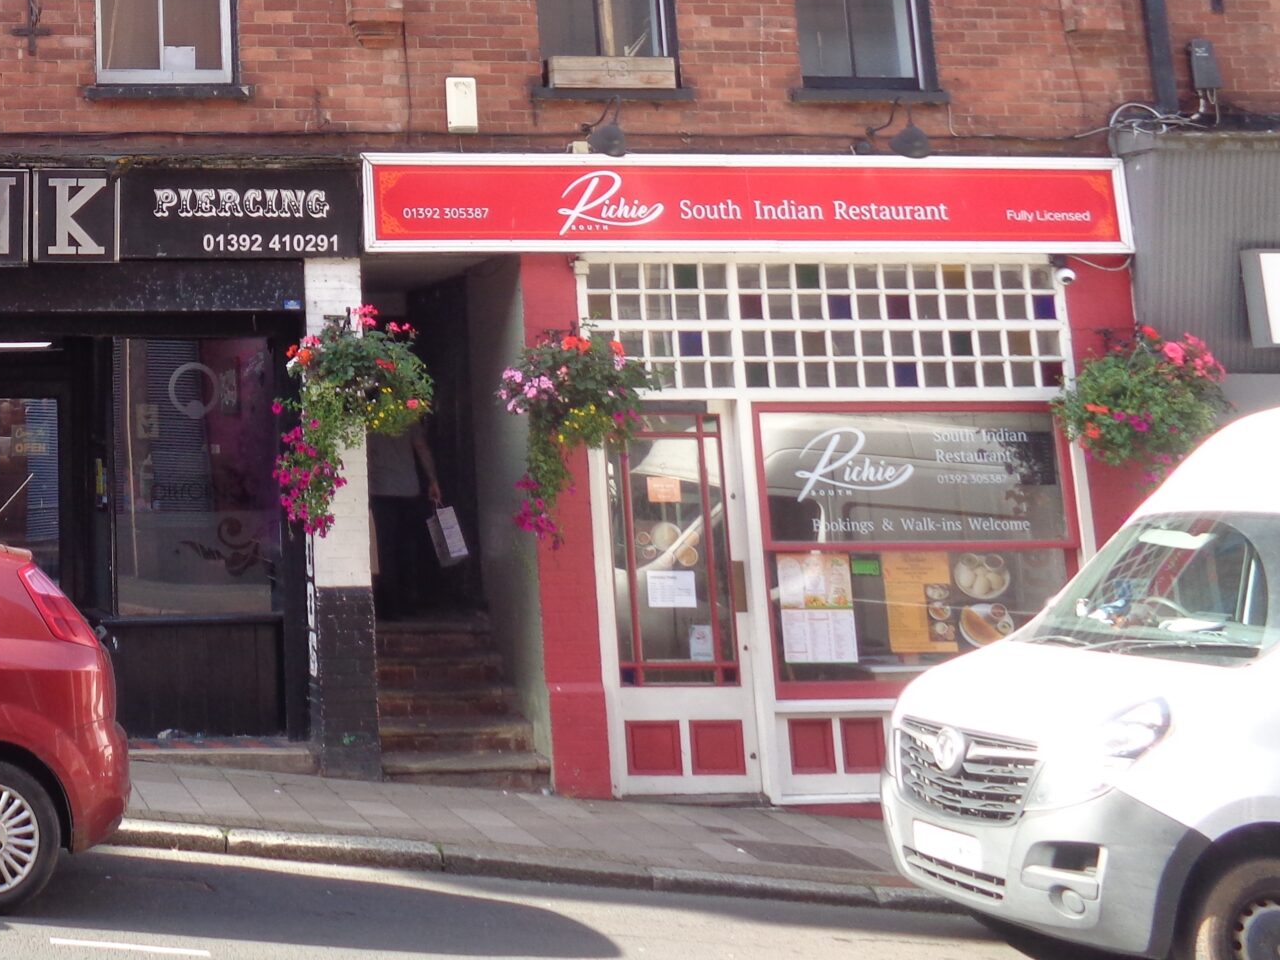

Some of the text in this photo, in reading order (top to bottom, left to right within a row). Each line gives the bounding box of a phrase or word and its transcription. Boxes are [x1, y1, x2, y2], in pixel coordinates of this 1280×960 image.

[153, 188, 330, 218] PIERCING
[557, 170, 665, 236] Richie
[679, 200, 949, 221] South Indian Restaurant
[402, 207, 489, 219] 01392 305387
[1006, 209, 1091, 222] Fully Licensed
[202, 234, 338, 252] 01392 410291
[933, 429, 1027, 443] South Indian
[935, 449, 1012, 463] Restaurant
[795, 427, 915, 503] Richie
[937, 473, 1007, 484] 01392 305387
[812, 518, 1031, 535] Bookings & Walk-ins Welcome
